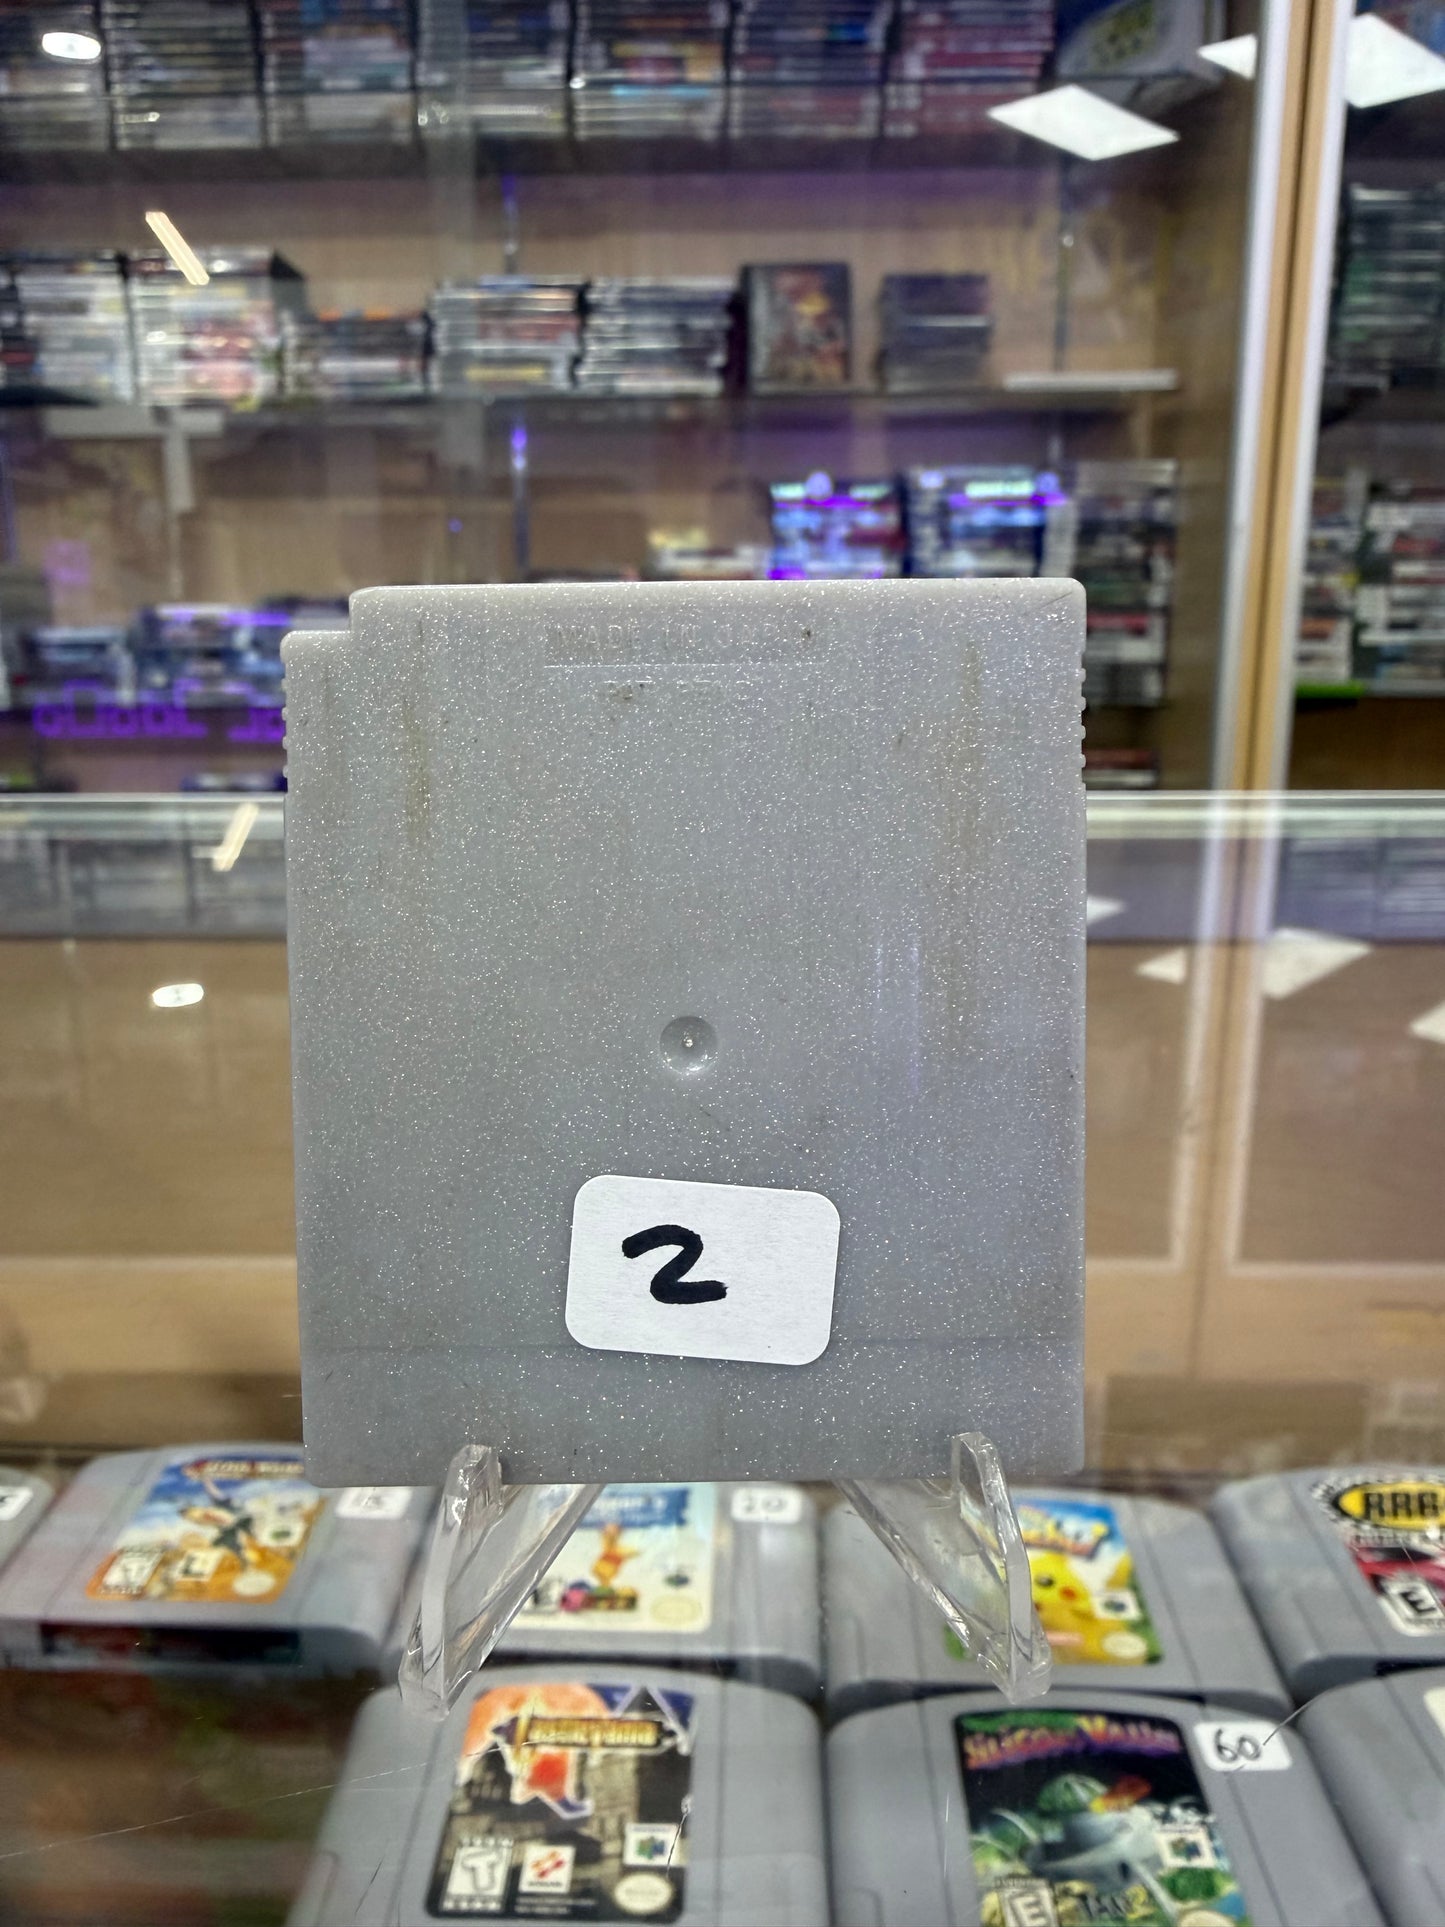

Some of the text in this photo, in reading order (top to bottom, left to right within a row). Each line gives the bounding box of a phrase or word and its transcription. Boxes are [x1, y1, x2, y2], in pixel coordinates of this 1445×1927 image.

[555, 623, 644, 650] MADE
[716, 622, 820, 650] JAP
[621, 1224, 729, 1305] 2
[1213, 1727, 1262, 1763] 60
